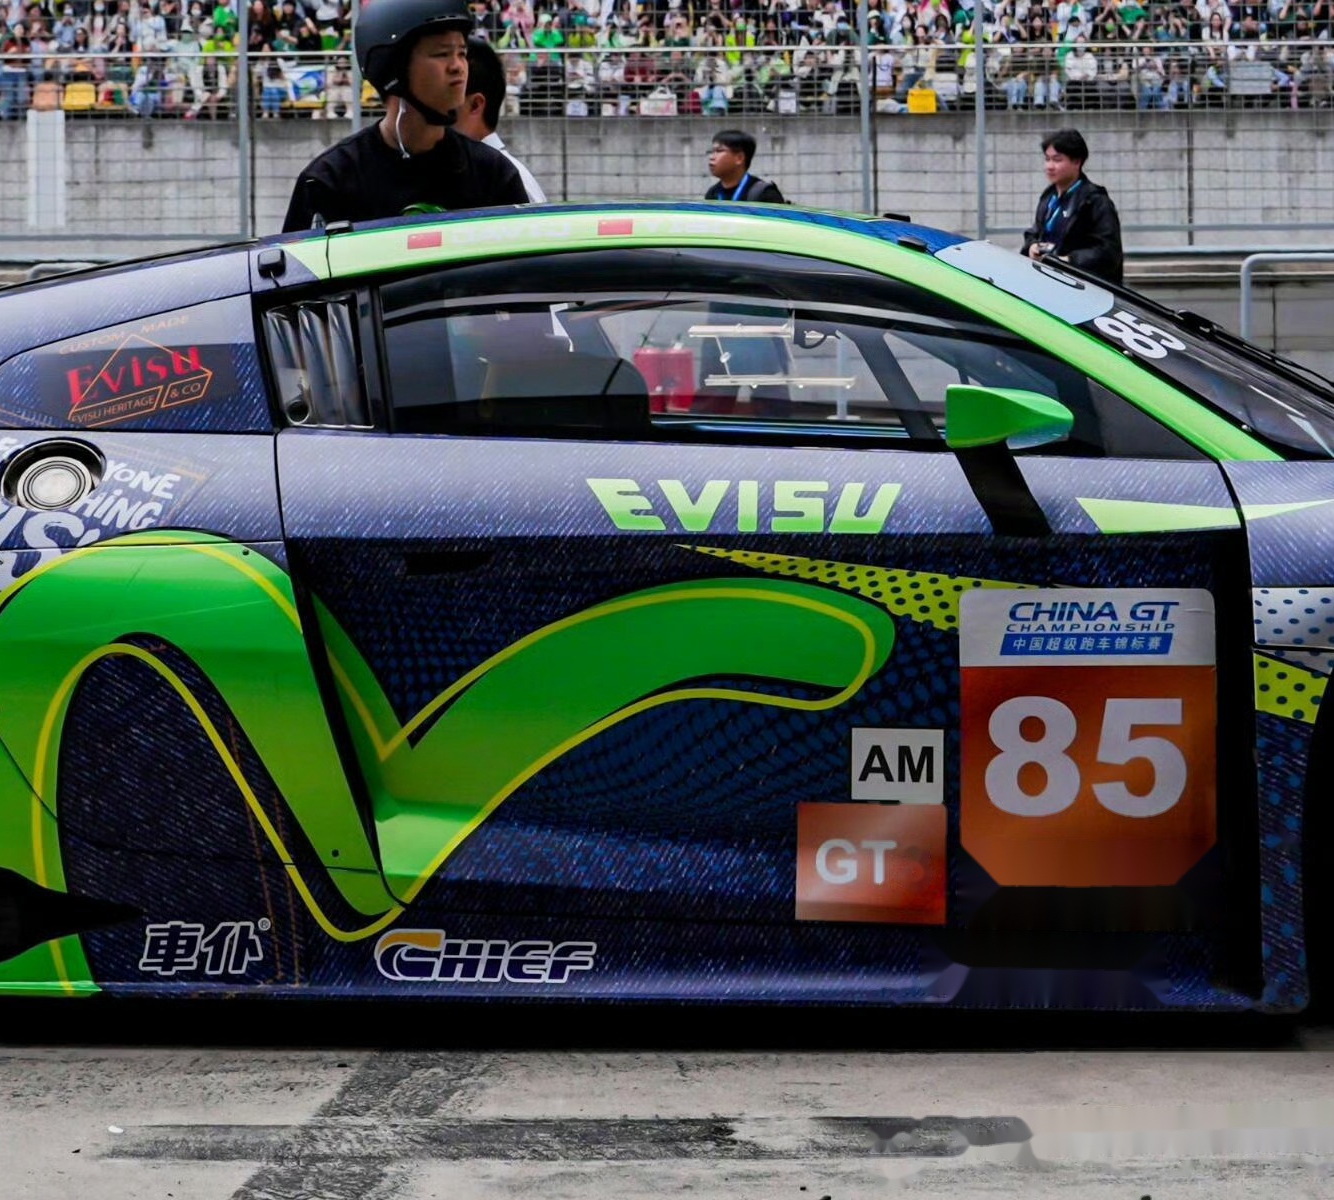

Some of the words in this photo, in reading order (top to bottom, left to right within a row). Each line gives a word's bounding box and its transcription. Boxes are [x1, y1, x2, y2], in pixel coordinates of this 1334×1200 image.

[1093, 311, 1187, 359] 85
[104, 395, 155, 416] HERITAGE
[169, 389, 180, 399] &
[182, 382, 201, 396] CO
[586, 478, 902, 534] EVISU
[1006, 623, 1176, 632] CHAMPIONSHIP
[1009, 602, 1119, 622] CHINA
[1130, 602, 1180, 622] GT
[1012, 636, 1163, 651] 中国超级跑车锦标赛
[858, 745, 936, 784] AM
[984, 696, 1187, 818] 85
[374, 929, 596, 983] CHIEF
